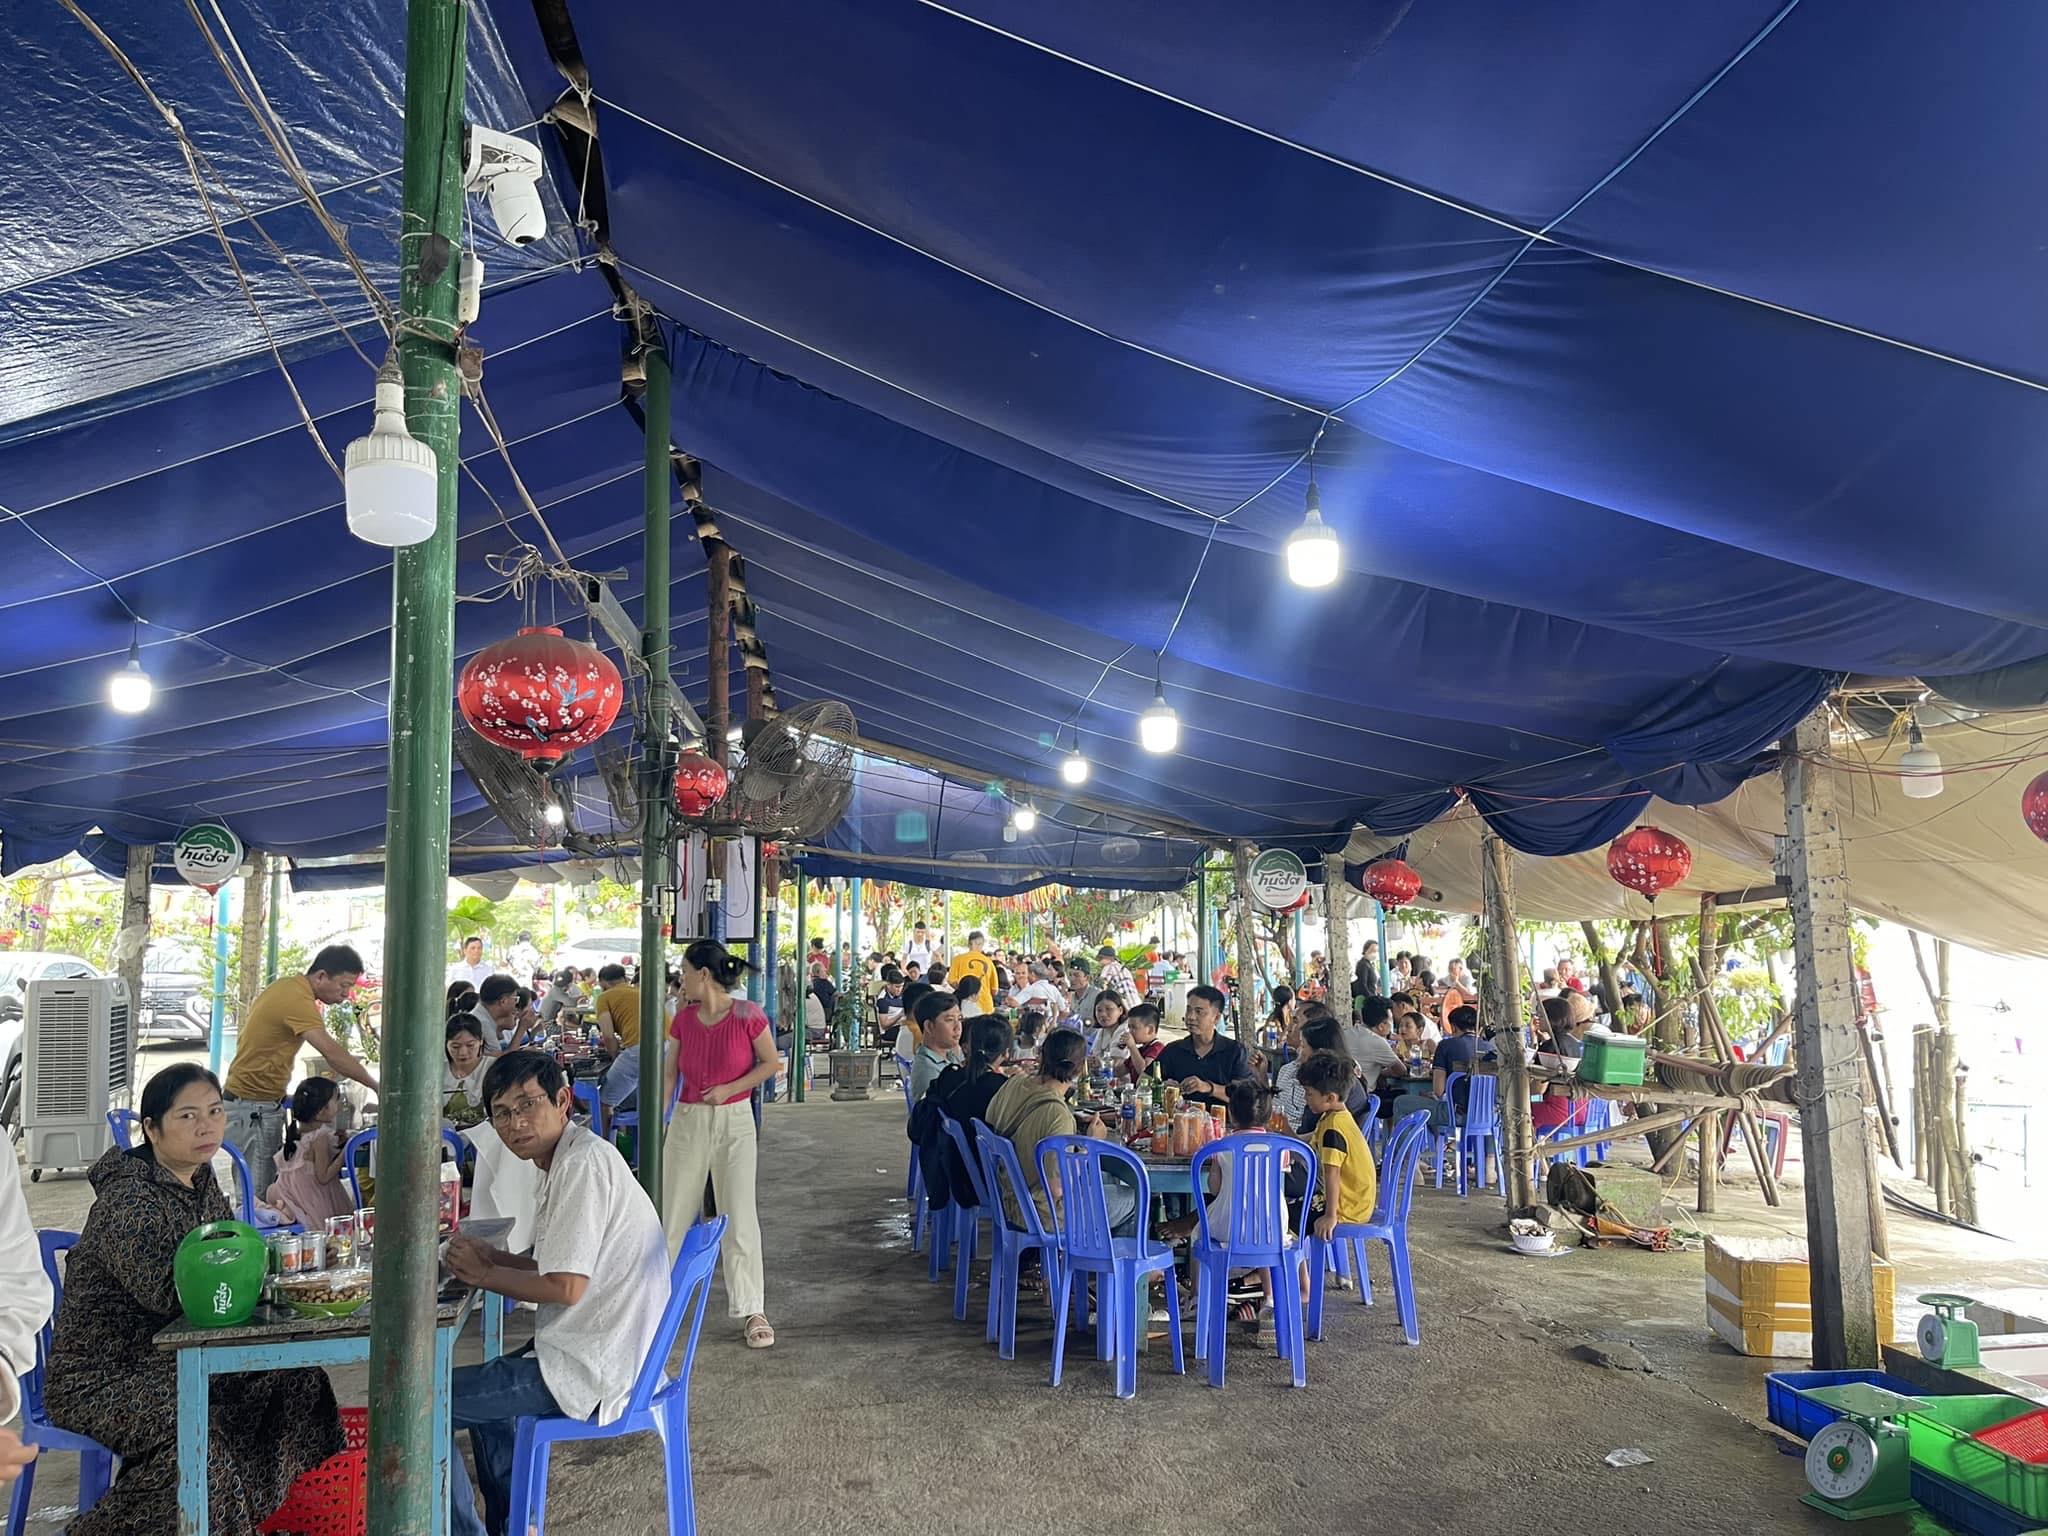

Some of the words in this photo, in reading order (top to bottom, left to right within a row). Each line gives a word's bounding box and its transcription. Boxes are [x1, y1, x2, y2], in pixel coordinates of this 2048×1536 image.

[180, 845, 230, 866] huda
[1258, 870, 1300, 889] huda
[213, 1282, 232, 1314] huda
